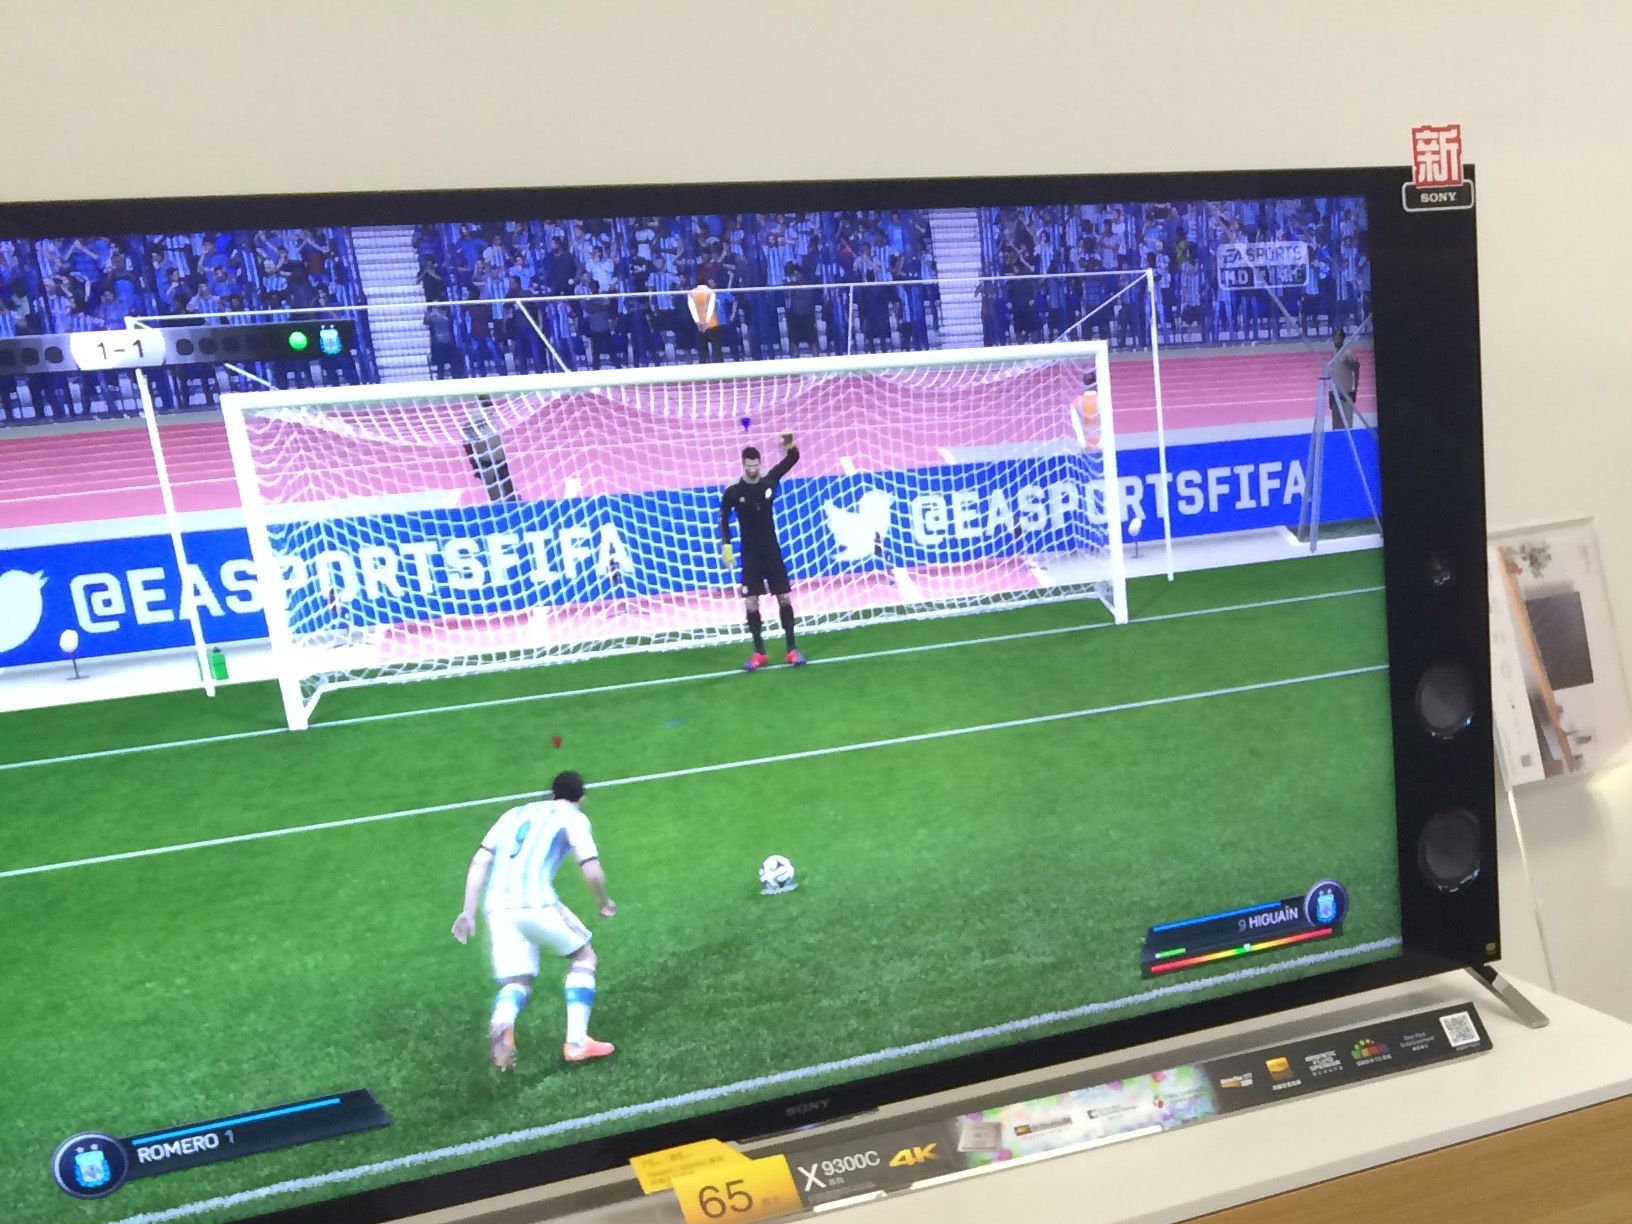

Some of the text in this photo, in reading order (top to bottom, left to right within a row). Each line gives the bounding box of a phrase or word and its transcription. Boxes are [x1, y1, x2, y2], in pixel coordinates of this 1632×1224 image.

[1415, 128, 1459, 183] 新
[1420, 191, 1457, 203] SONY
[1246, 246, 1302, 263] SPORTS
[1237, 918, 1247, 933] 9
[785, 1098, 830, 1118] SONY
[136, 1129, 235, 1164] ROMERO 1
[698, 1179, 754, 1219] 65
[888, 1142, 940, 1168] 4K
